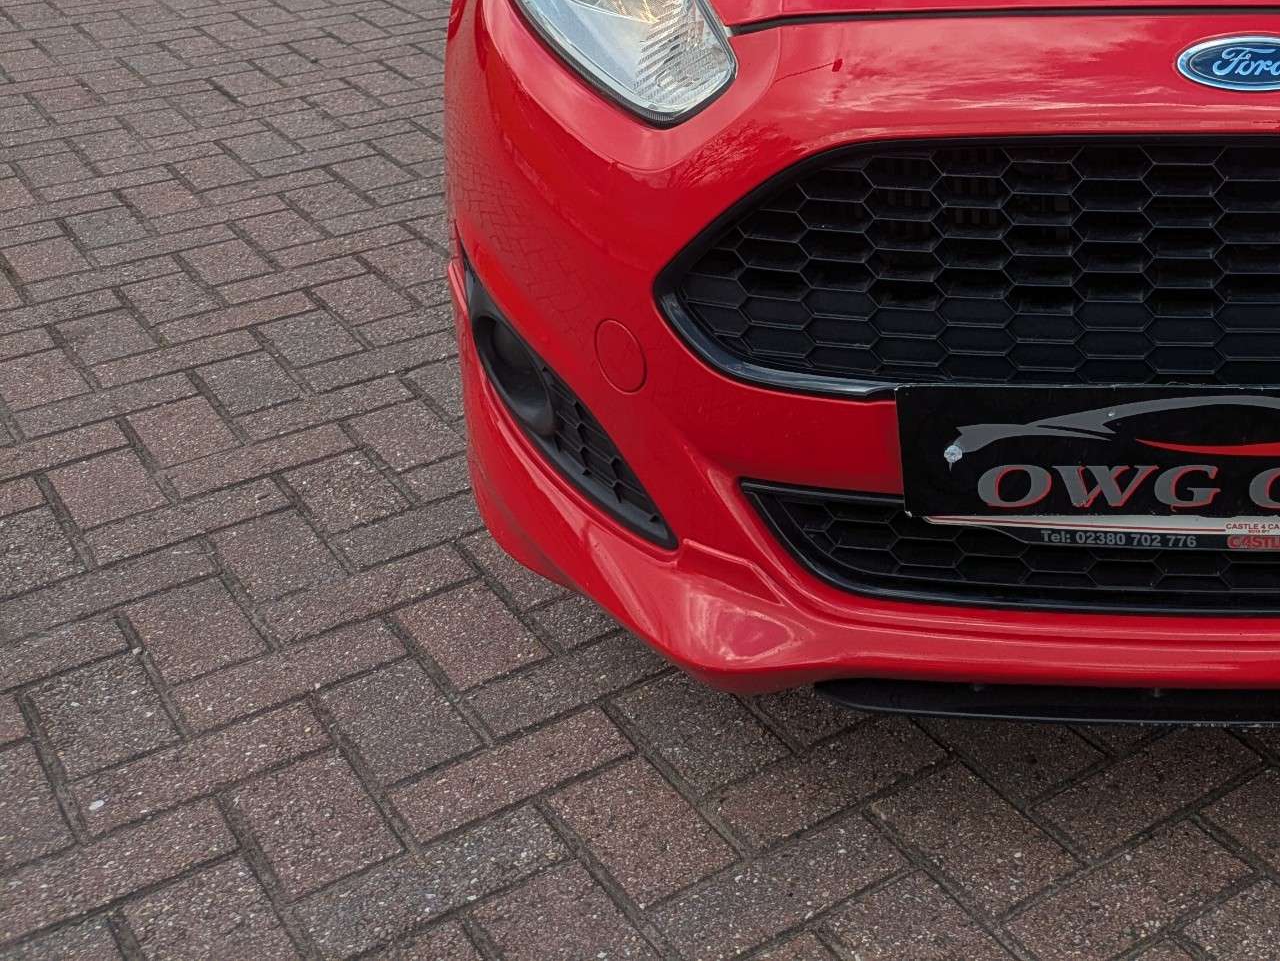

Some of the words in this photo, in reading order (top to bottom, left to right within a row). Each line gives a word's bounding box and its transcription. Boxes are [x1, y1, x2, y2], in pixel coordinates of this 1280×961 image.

[977, 463, 1222, 509] OWG
[1040, 530, 1071, 543] Tel:
[1075, 531, 1126, 545] 02380
[1131, 533, 1162, 547] 702
[1166, 534, 1197, 547] 776
